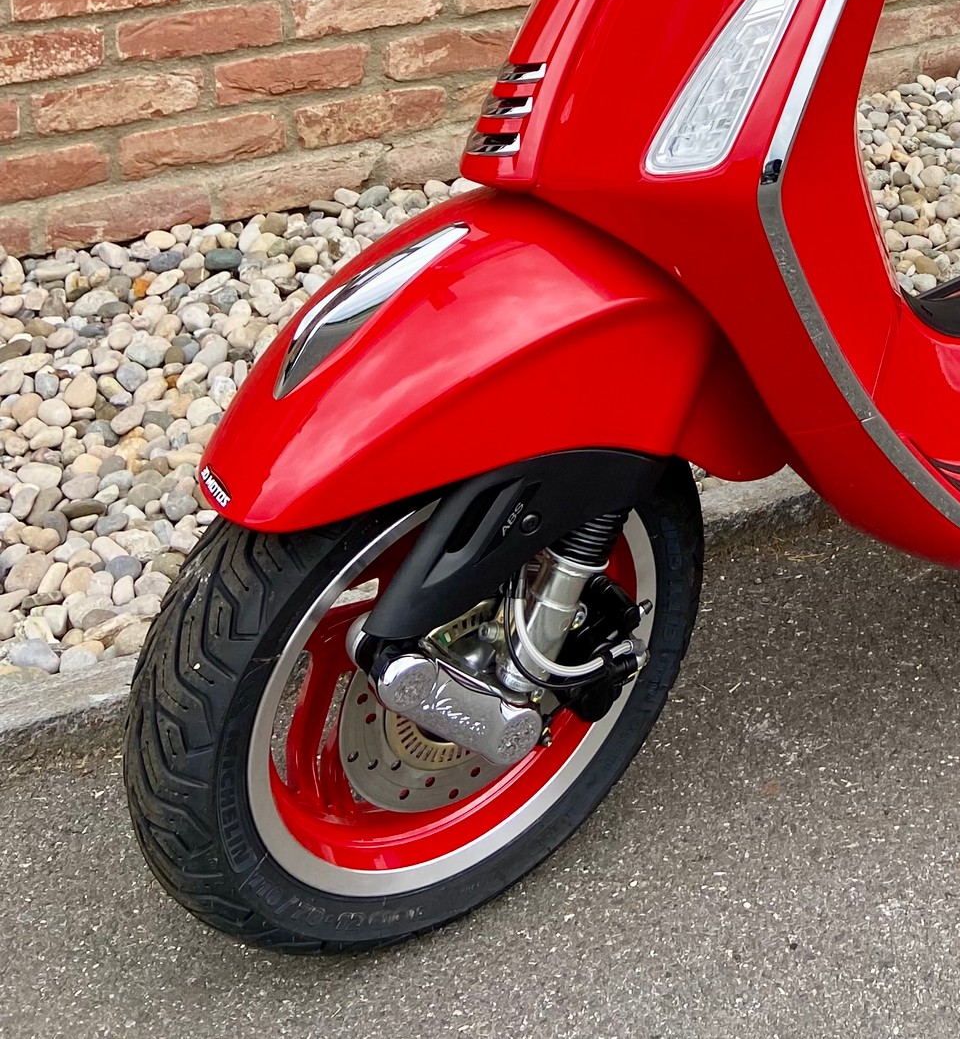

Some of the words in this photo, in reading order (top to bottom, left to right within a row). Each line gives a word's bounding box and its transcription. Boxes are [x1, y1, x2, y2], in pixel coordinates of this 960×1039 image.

[205, 475, 231, 508] MOTOS
[502, 502, 524, 537] ABS
[219, 729, 252, 866] MICHELIN
